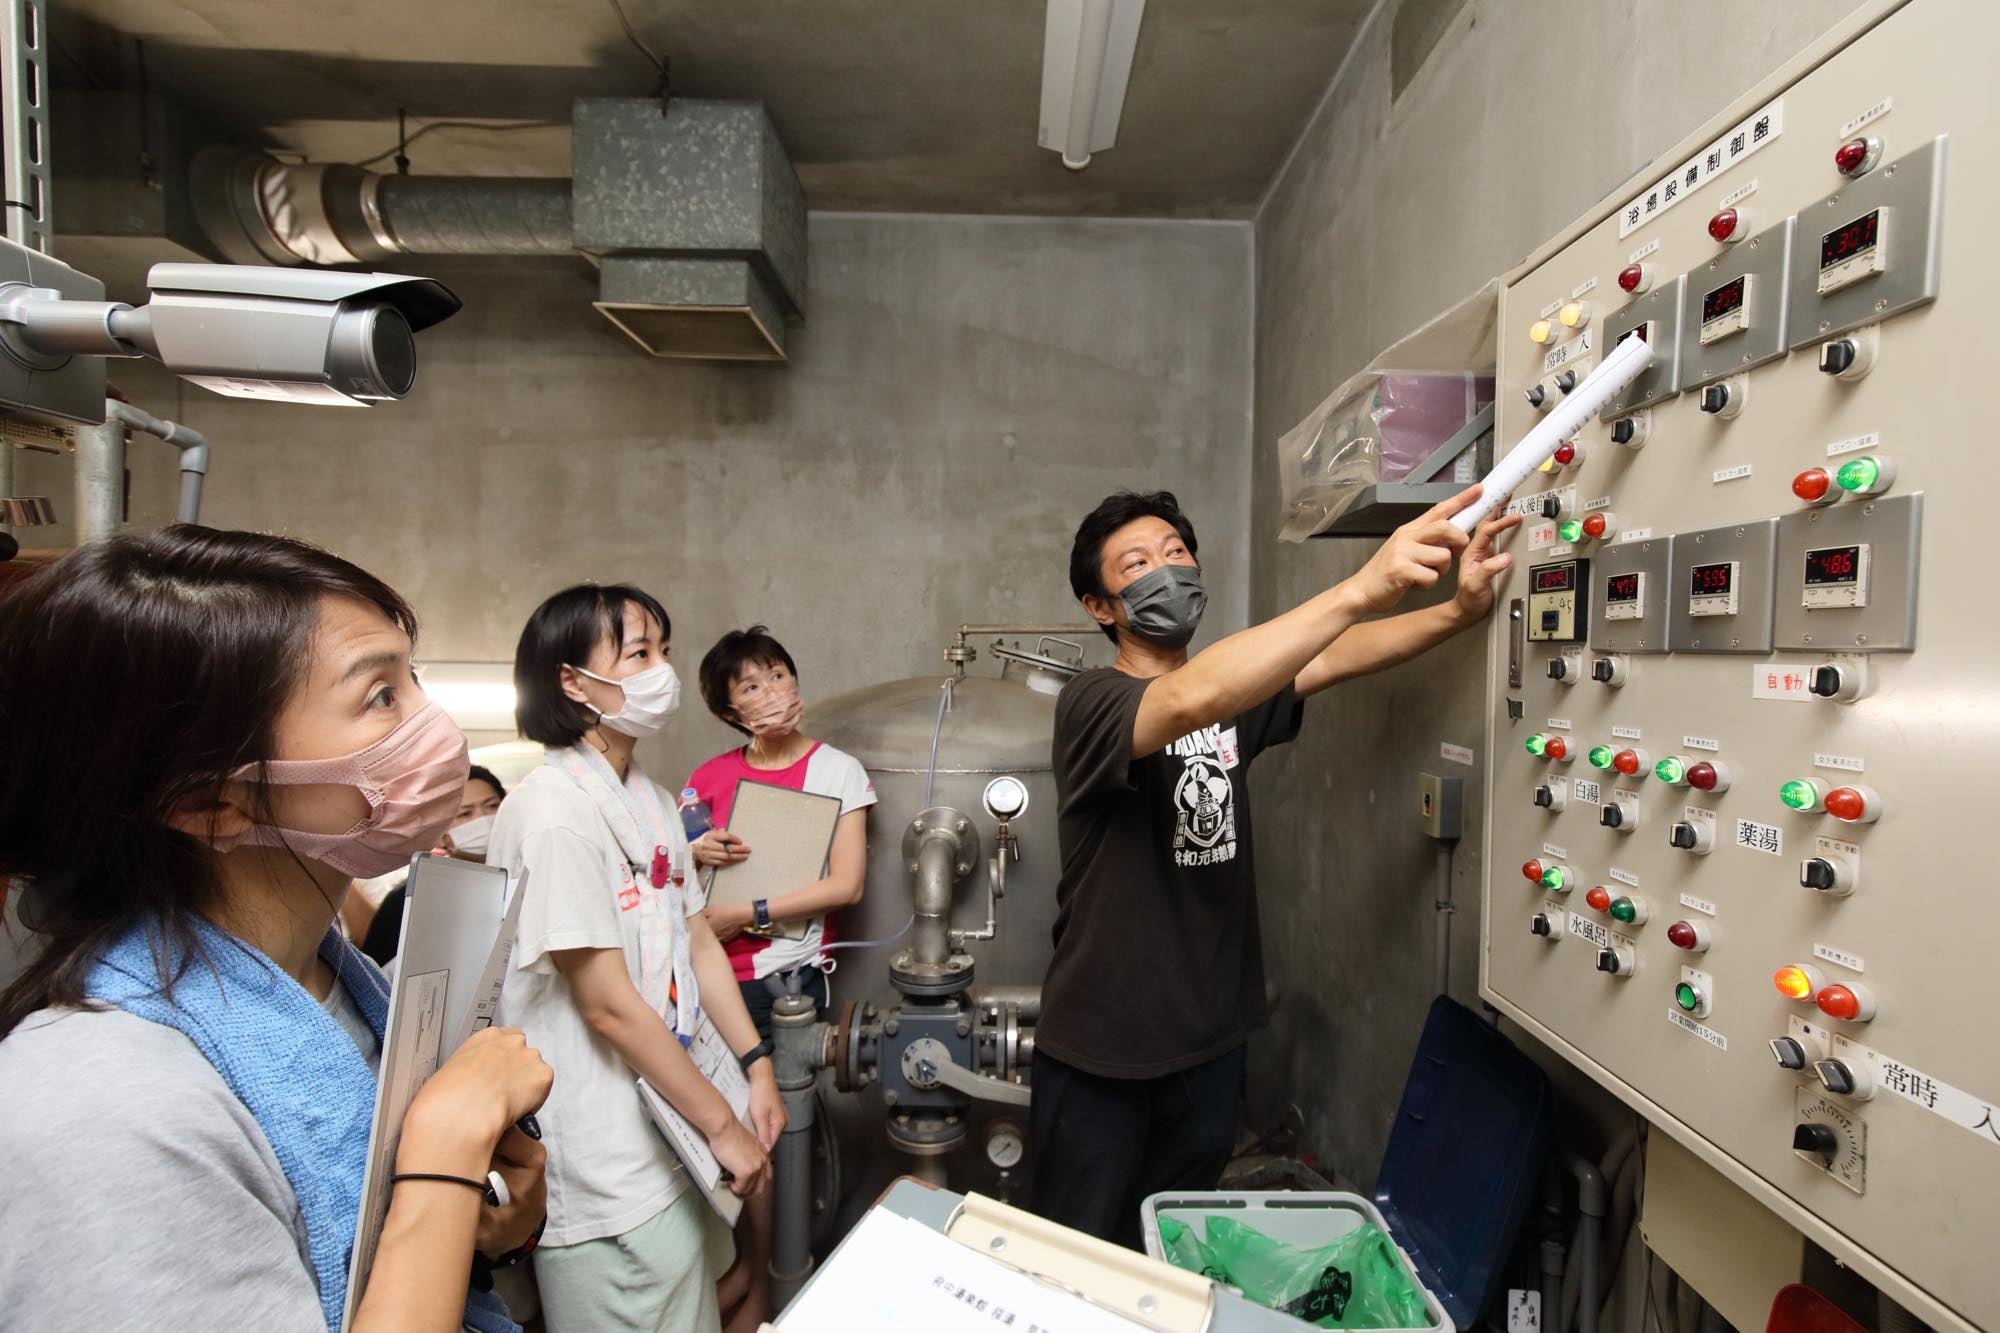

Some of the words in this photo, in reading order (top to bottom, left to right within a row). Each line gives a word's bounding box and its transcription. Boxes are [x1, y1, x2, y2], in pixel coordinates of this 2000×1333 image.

[1628, 115, 1769, 227] 浴場設備制御盤
[1559, 598, 1572, 614] 45
[1768, 672, 1803, 691] 自動
[1576, 781, 1598, 803] 白湯
[1739, 822, 1778, 852] 薬湯
[1571, 916, 1606, 947] 水風呂
[1883, 1063, 1938, 1108] 常時
[1972, 1105, 2000, 1141] 入
